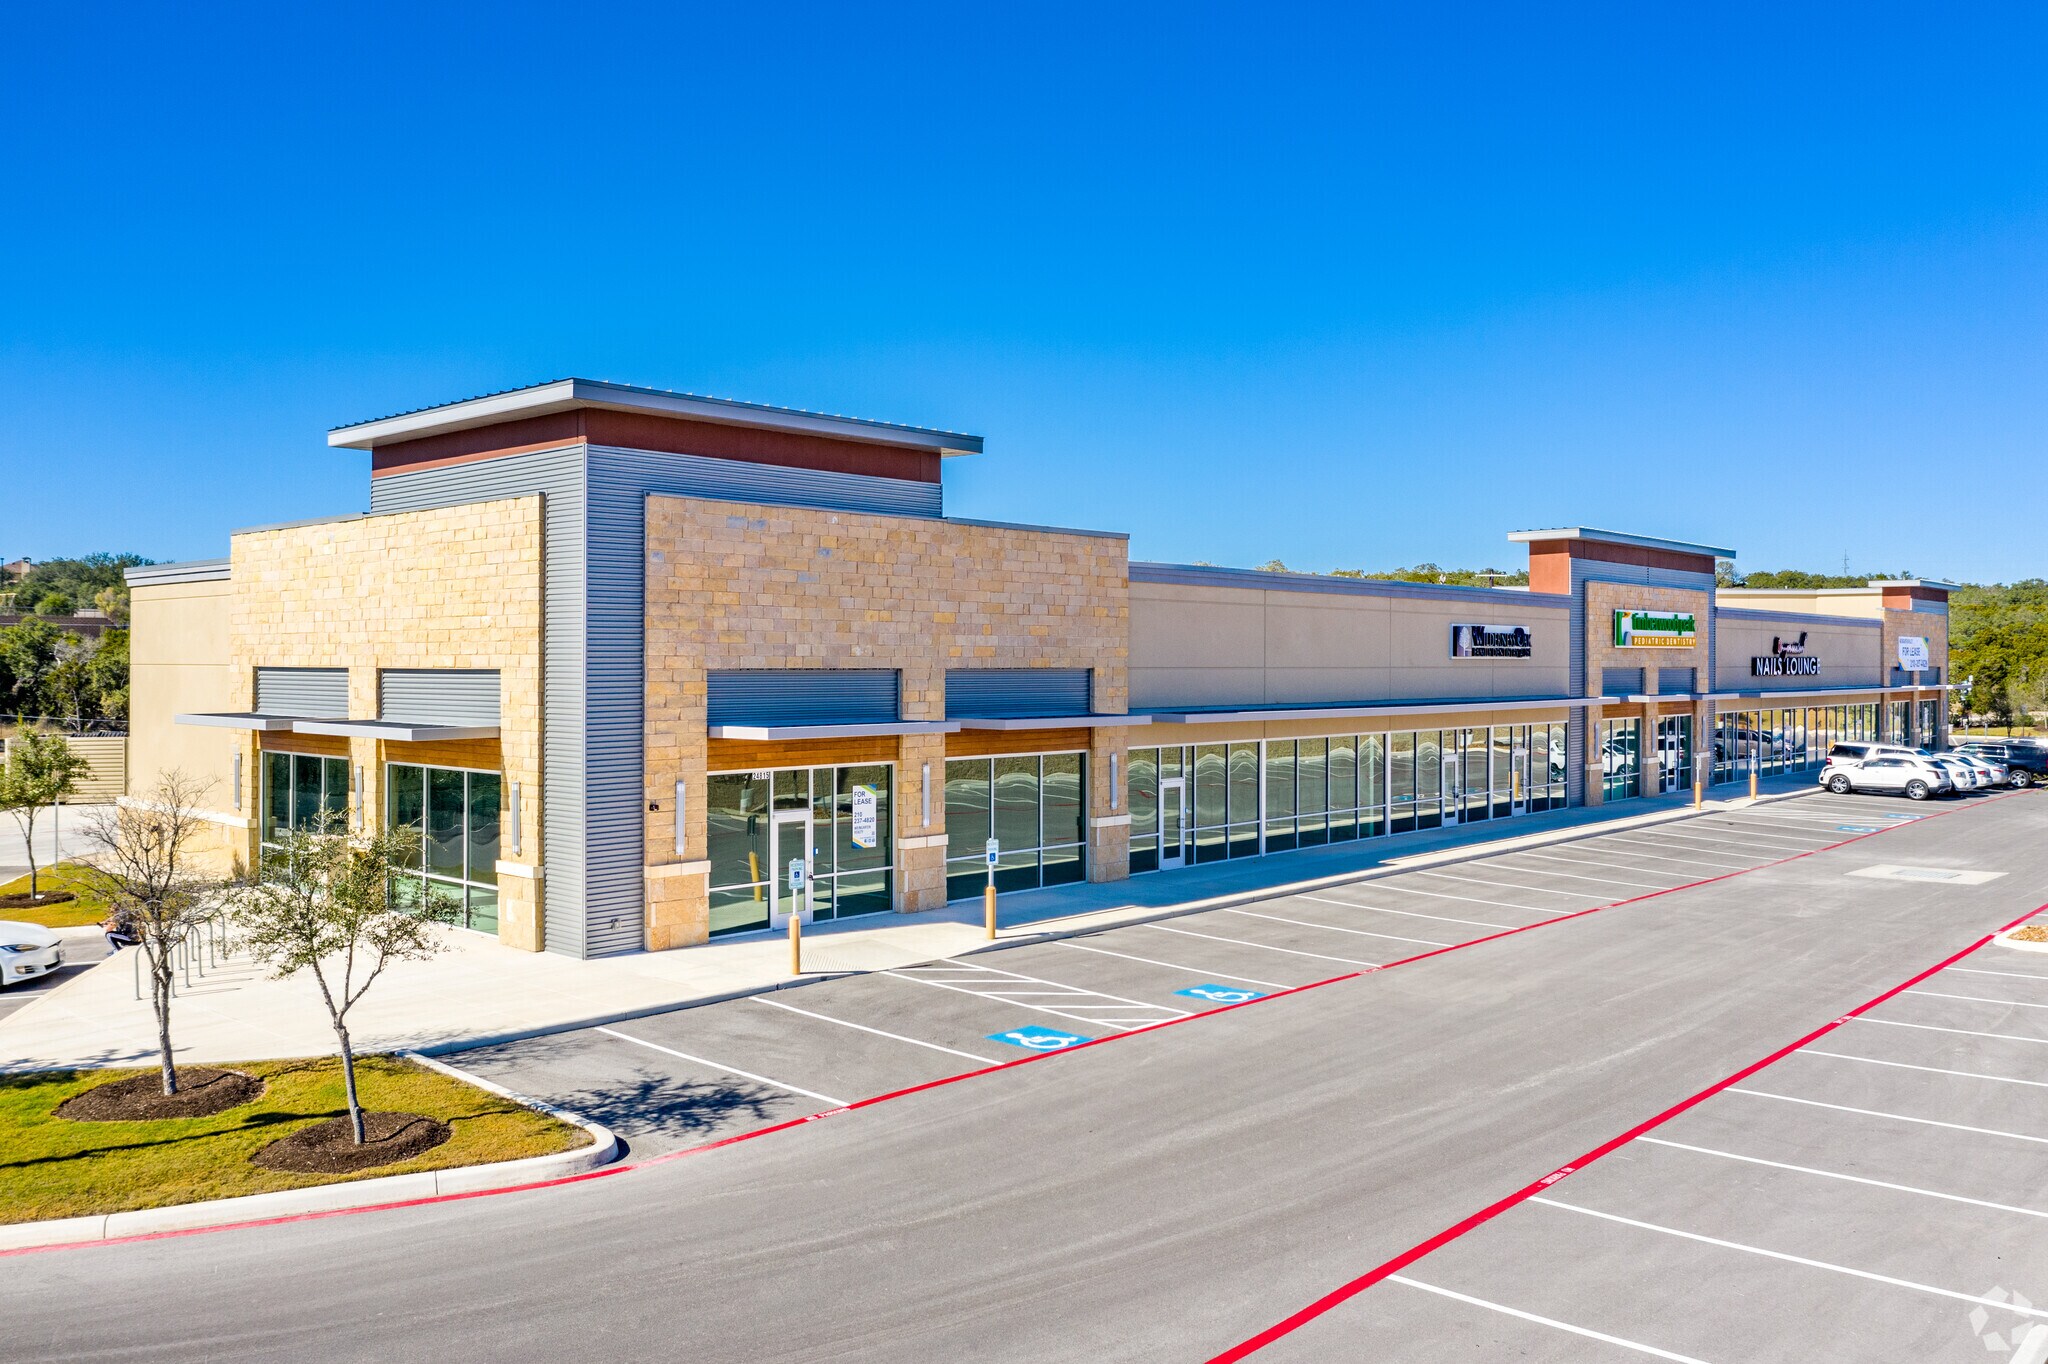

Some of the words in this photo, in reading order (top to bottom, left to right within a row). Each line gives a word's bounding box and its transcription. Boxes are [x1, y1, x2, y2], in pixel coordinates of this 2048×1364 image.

[1634, 637, 1665, 646] PEDIATRIC
[1666, 638, 1696, 646] DENTISTRY
[1756, 657, 1782, 676] NAILS
[1786, 657, 1820, 675] LOUNGE
[854, 798, 872, 806] LEASE
